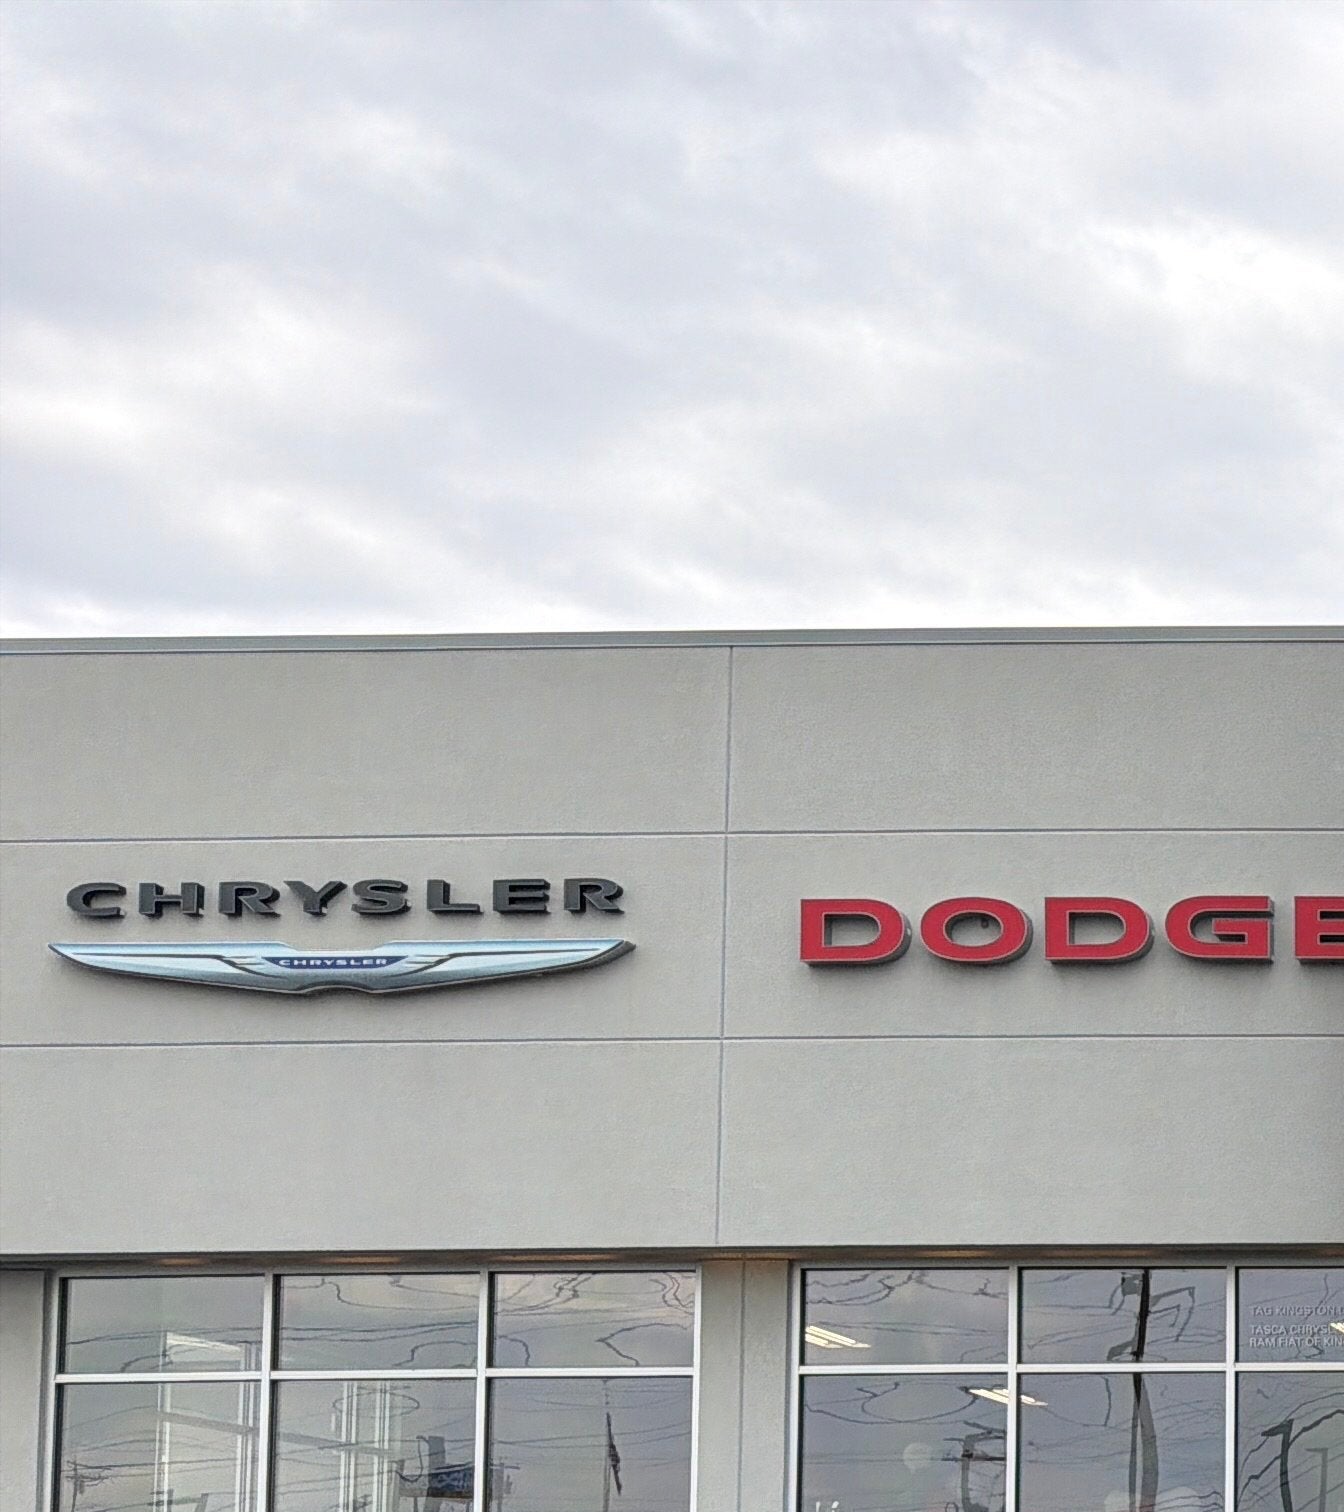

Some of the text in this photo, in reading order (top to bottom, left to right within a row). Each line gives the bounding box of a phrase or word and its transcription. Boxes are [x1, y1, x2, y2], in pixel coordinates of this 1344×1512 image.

[66, 877, 625, 917] CHRYSLER
[278, 958, 388, 966] CHRYSLER
[1275, 1306, 1334, 1316] KINGSTON
[1250, 1324, 1286, 1335] TASCA
[1289, 1324, 1338, 1335] CHRYSL
[1250, 1337, 1275, 1347] RAM
[1279, 1337, 1302, 1347] FIAT
[1304, 1337, 1321, 1347] OF
